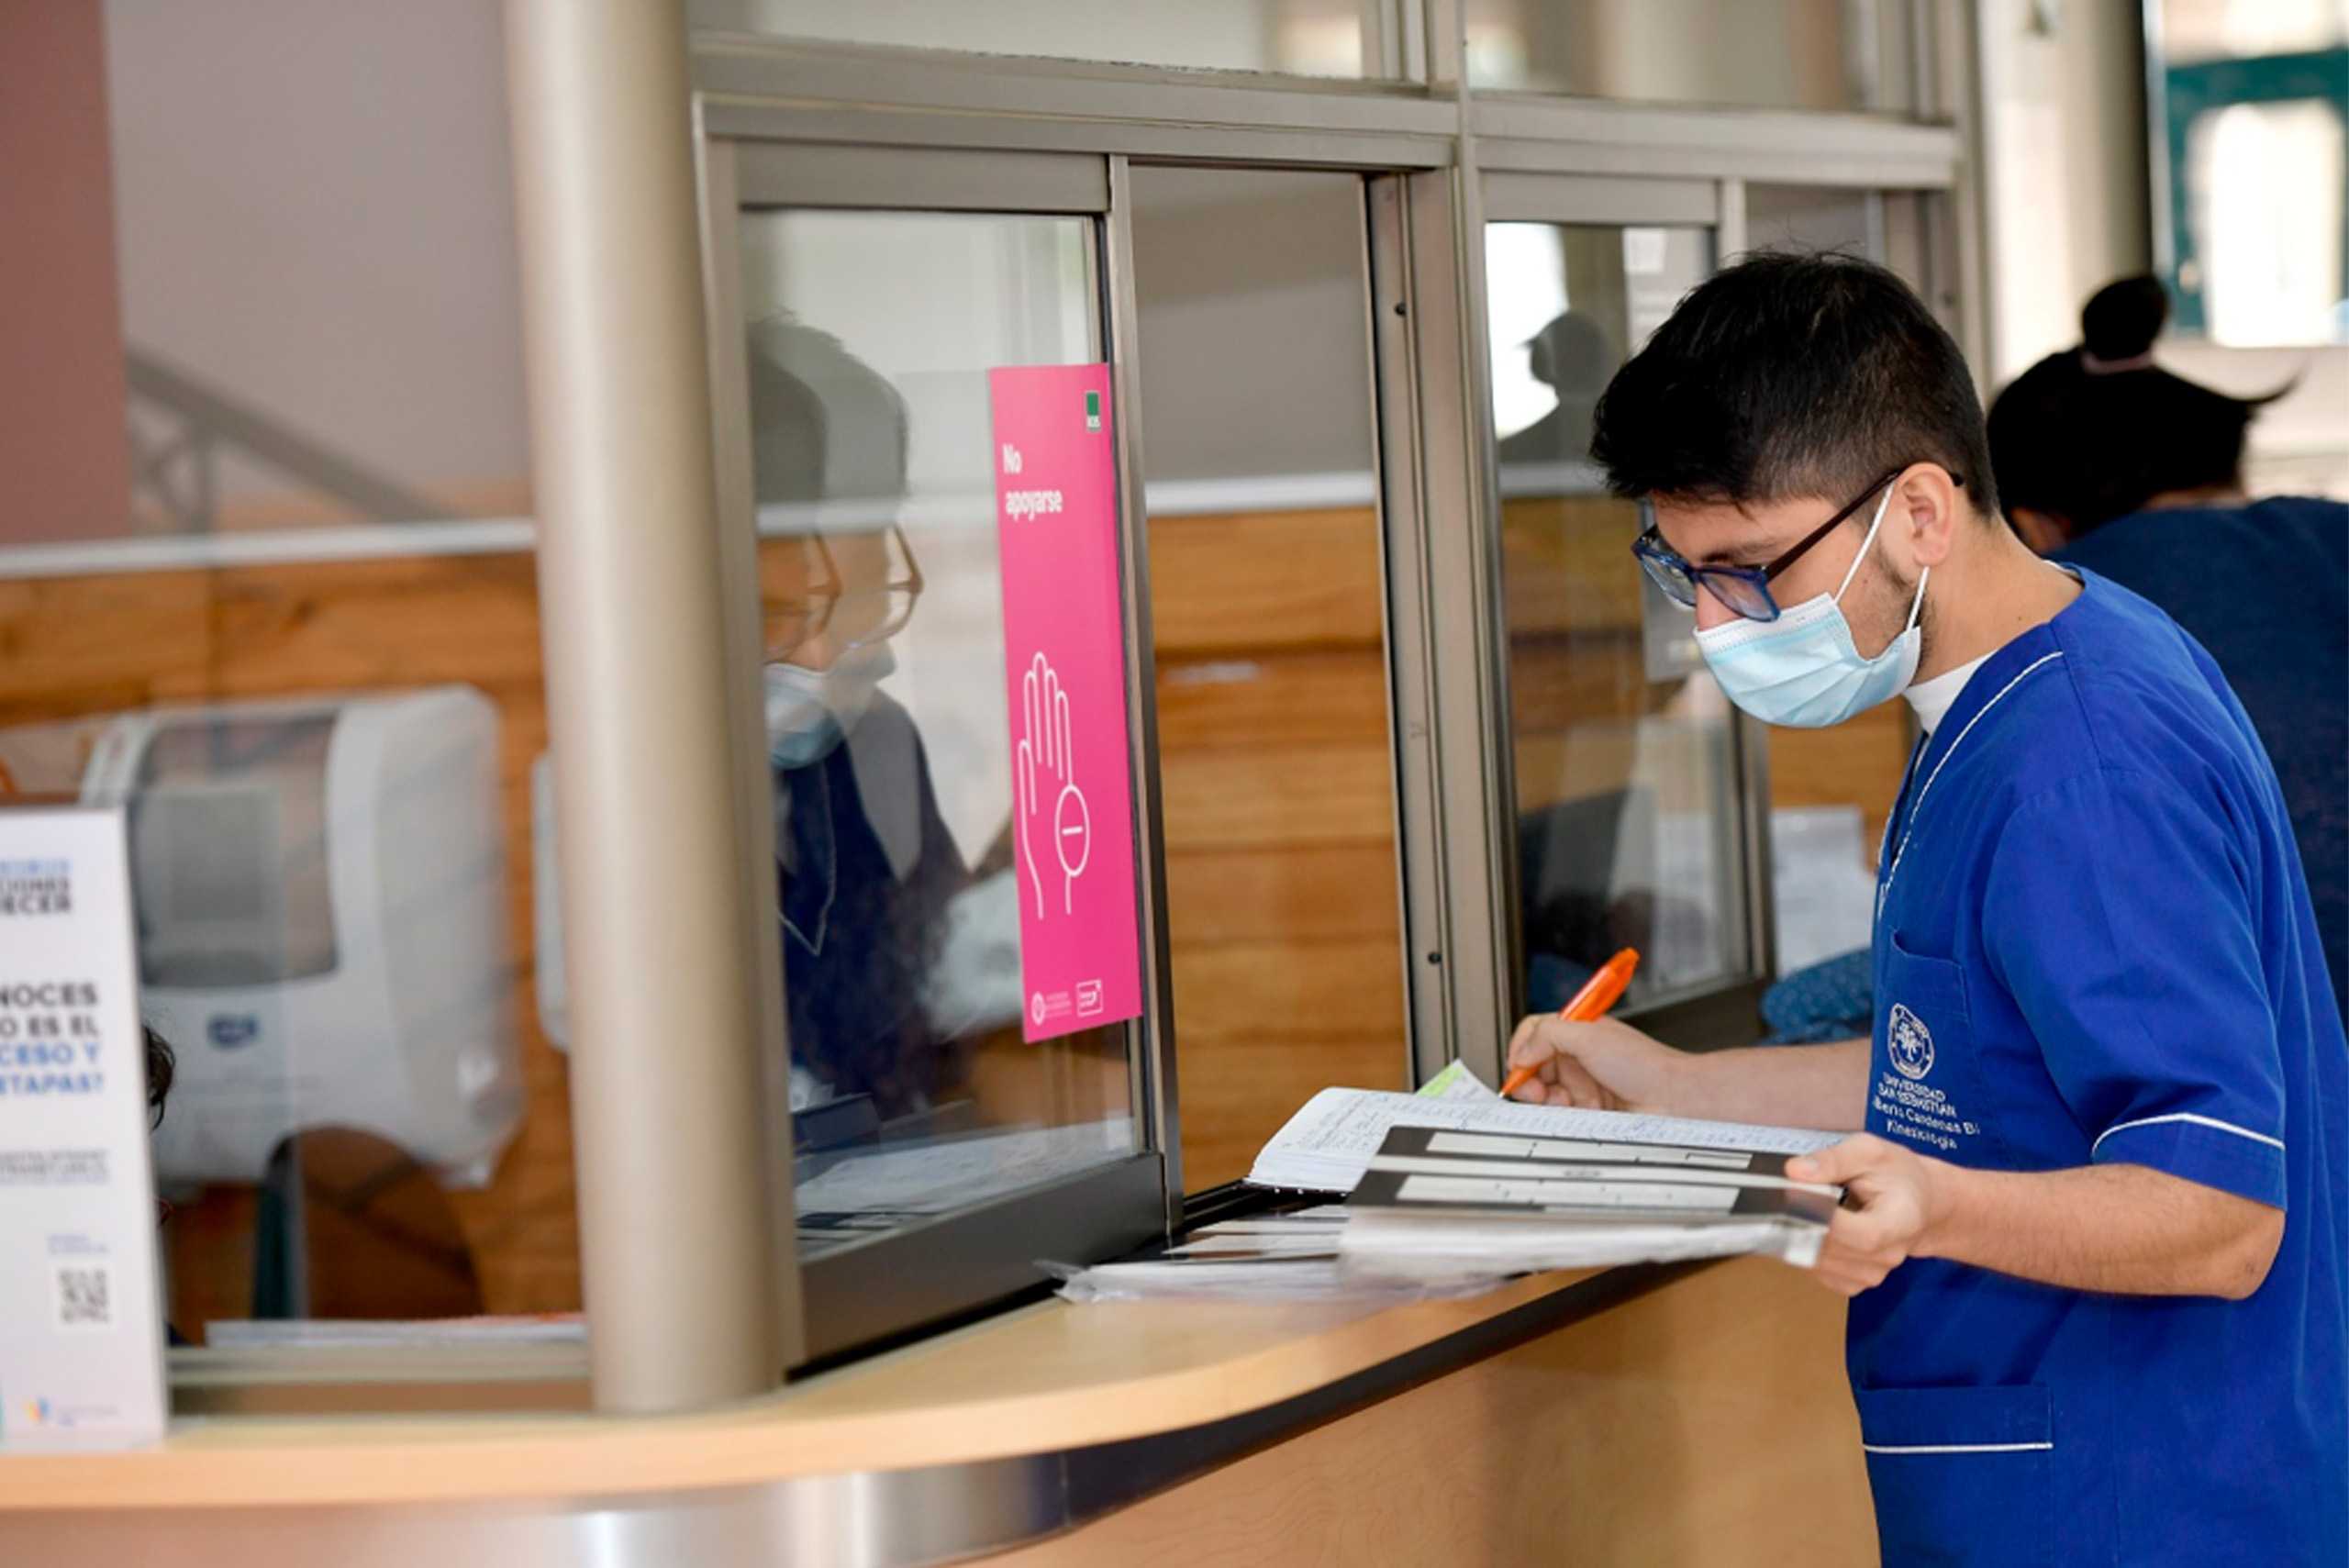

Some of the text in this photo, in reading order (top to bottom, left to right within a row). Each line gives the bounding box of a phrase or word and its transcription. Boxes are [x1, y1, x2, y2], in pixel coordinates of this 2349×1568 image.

[1003, 443, 1022, 473] No
[1005, 489, 1063, 522] apoyarse
[28, 1016, 60, 1037] ES
[71, 1015, 99, 1038] EL
[83, 1041, 99, 1065] Y
